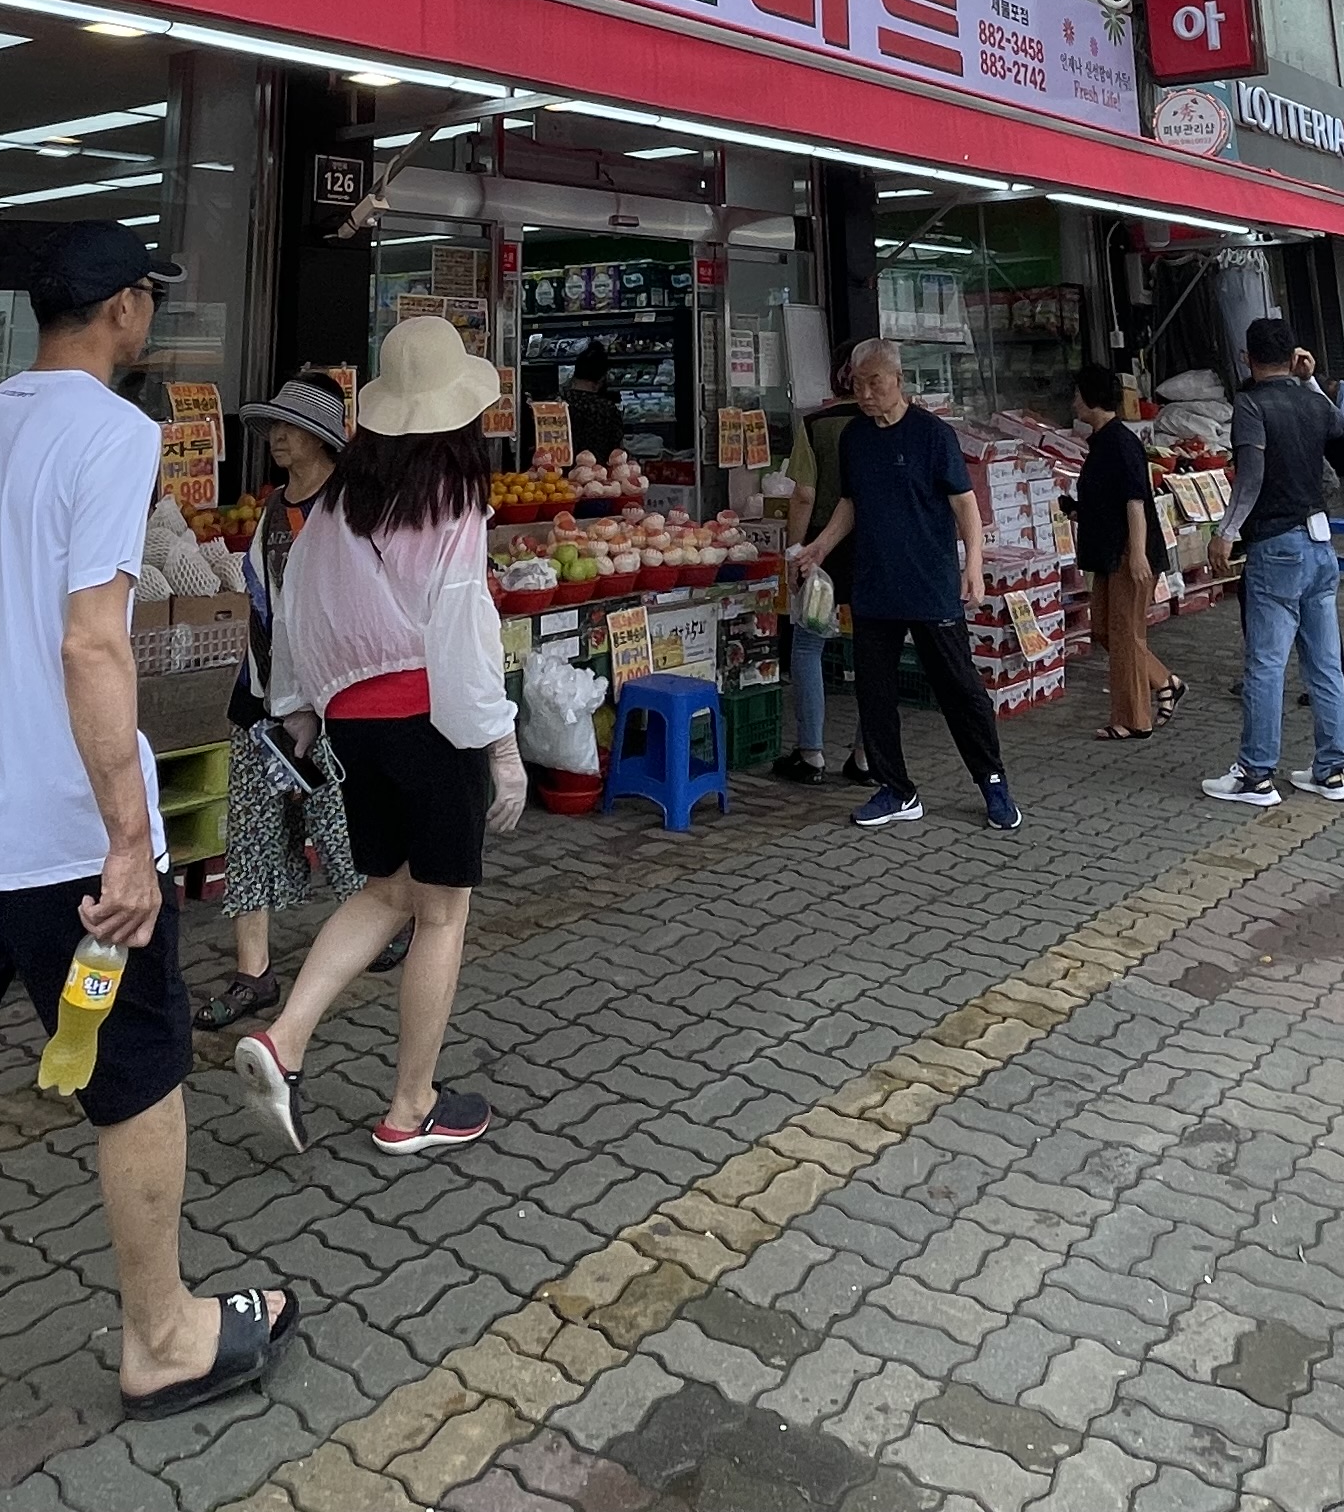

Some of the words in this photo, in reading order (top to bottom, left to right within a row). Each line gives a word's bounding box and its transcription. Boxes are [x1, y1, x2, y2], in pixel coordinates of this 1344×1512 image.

[978, 19, 1045, 64] 882-3458
[980, 49, 1047, 93] 883-2742
[1073, 80, 1099, 104] Fresh
[324, 172, 354, 192] 126
[163, 439, 213, 457] 자두
[83, 973, 113, 998] 환타
